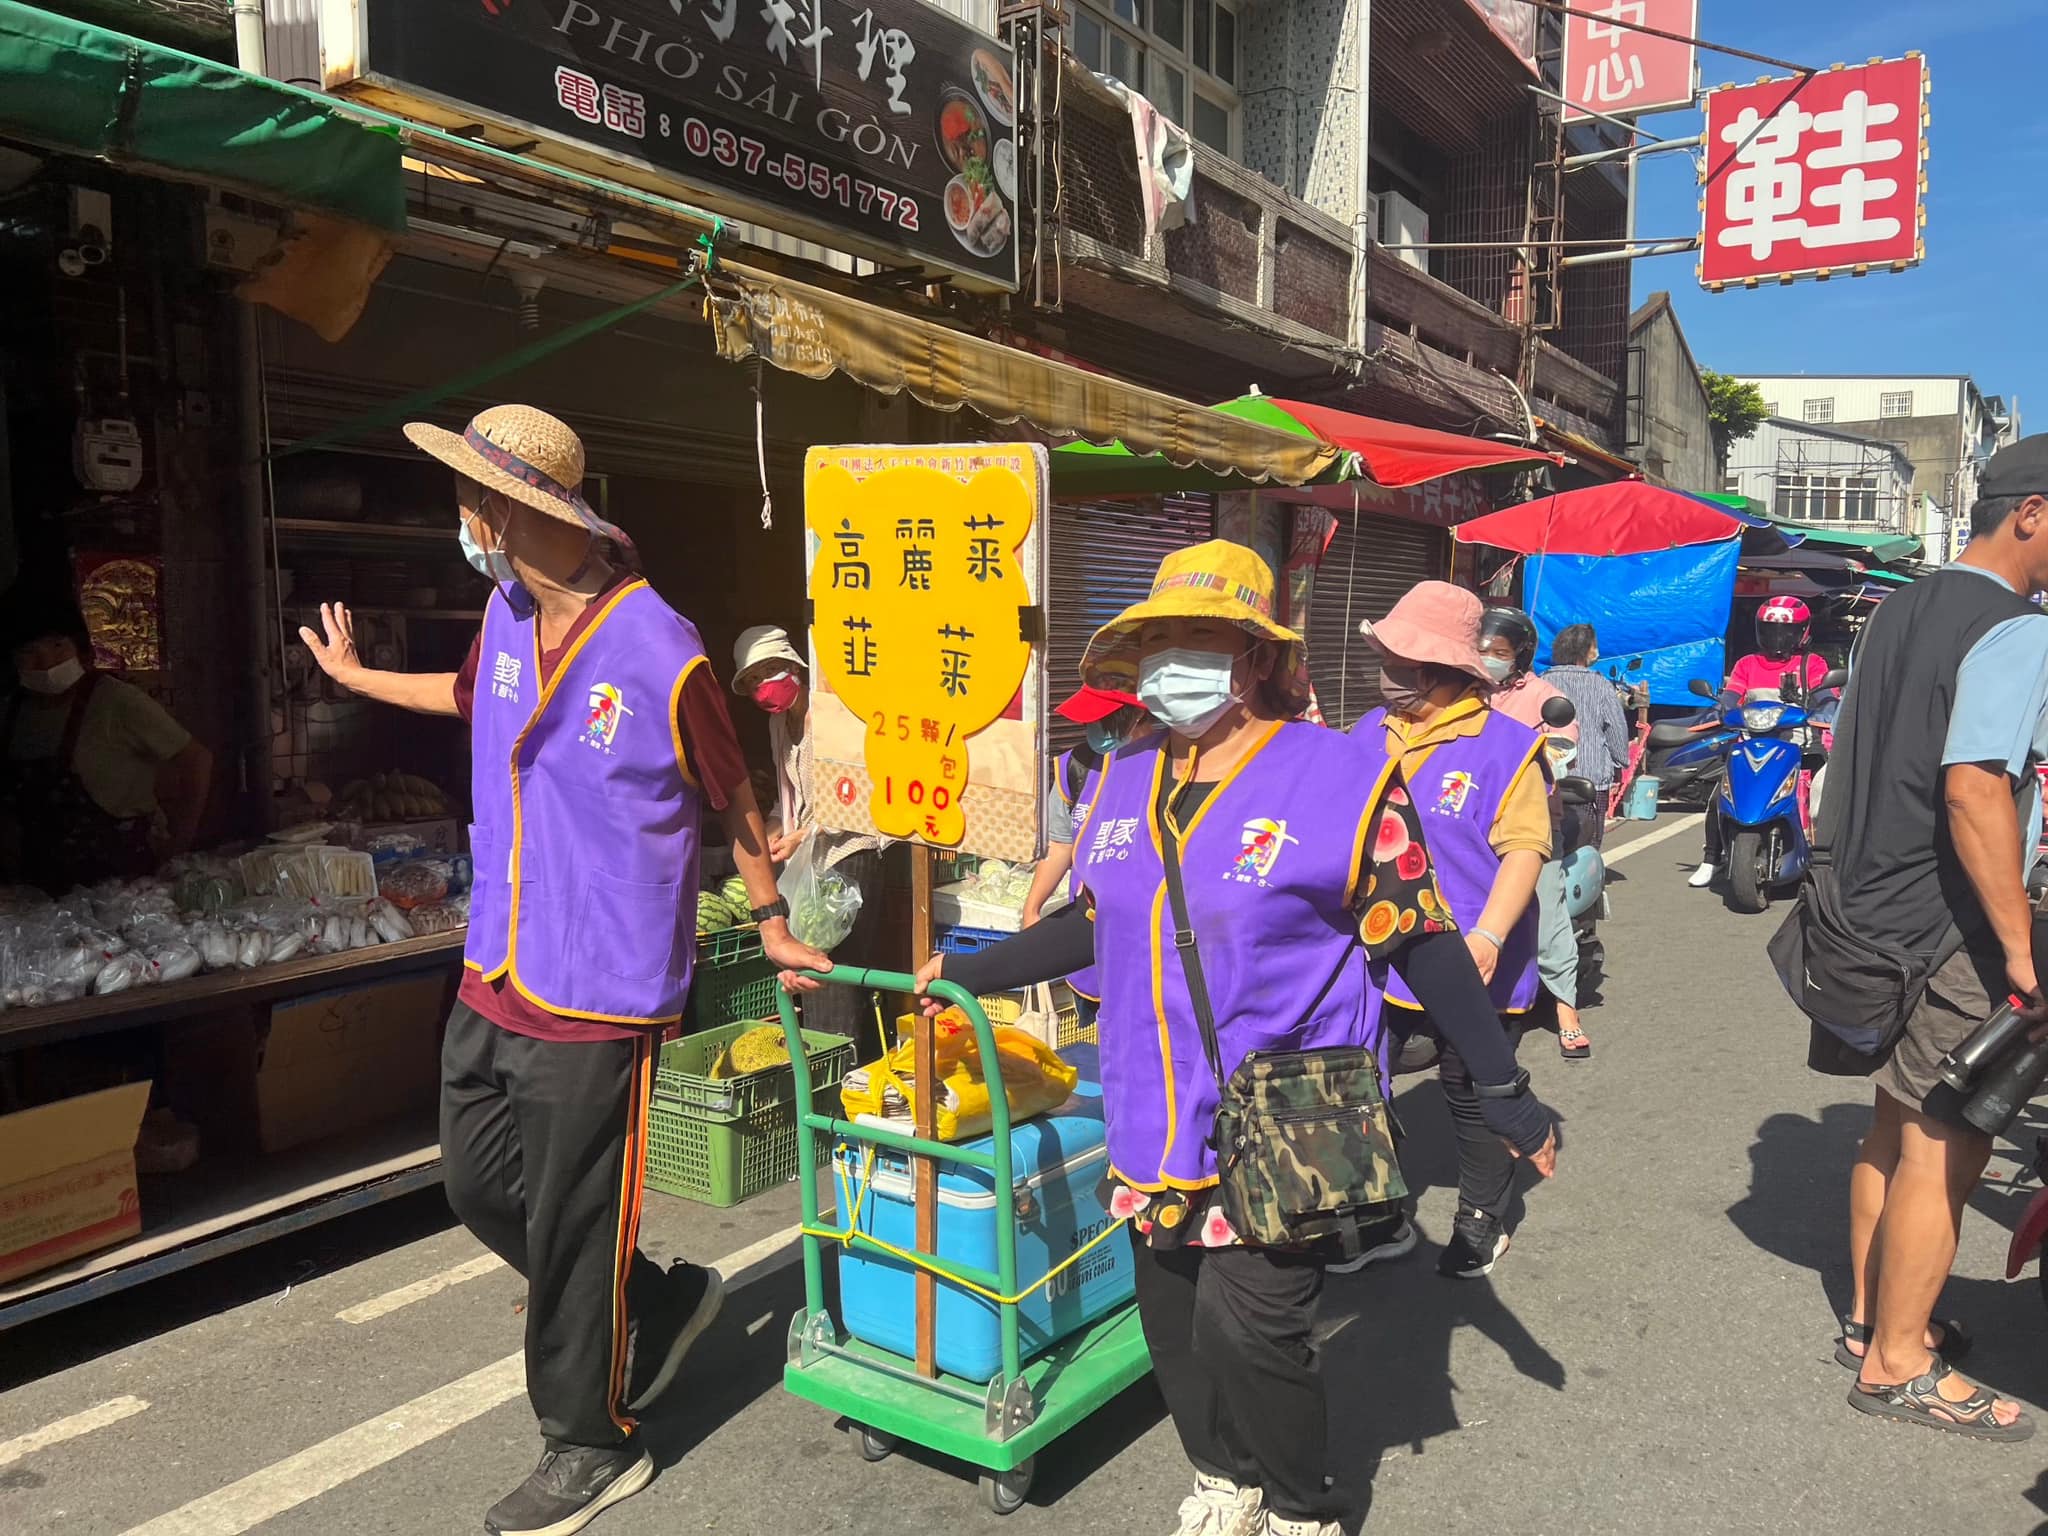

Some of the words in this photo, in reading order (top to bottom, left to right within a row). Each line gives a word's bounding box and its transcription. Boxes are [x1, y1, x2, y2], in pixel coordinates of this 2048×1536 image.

[714, 65, 804, 126] SÀI
[816, 107, 922, 170] GÒN
[684, 118, 919, 231] 037-551772
[1717, 90, 1903, 261] 鞋
[832, 513, 1005, 591] 高麗菜
[885, 775, 950, 811] 100
[925, 815, 940, 838] 元
